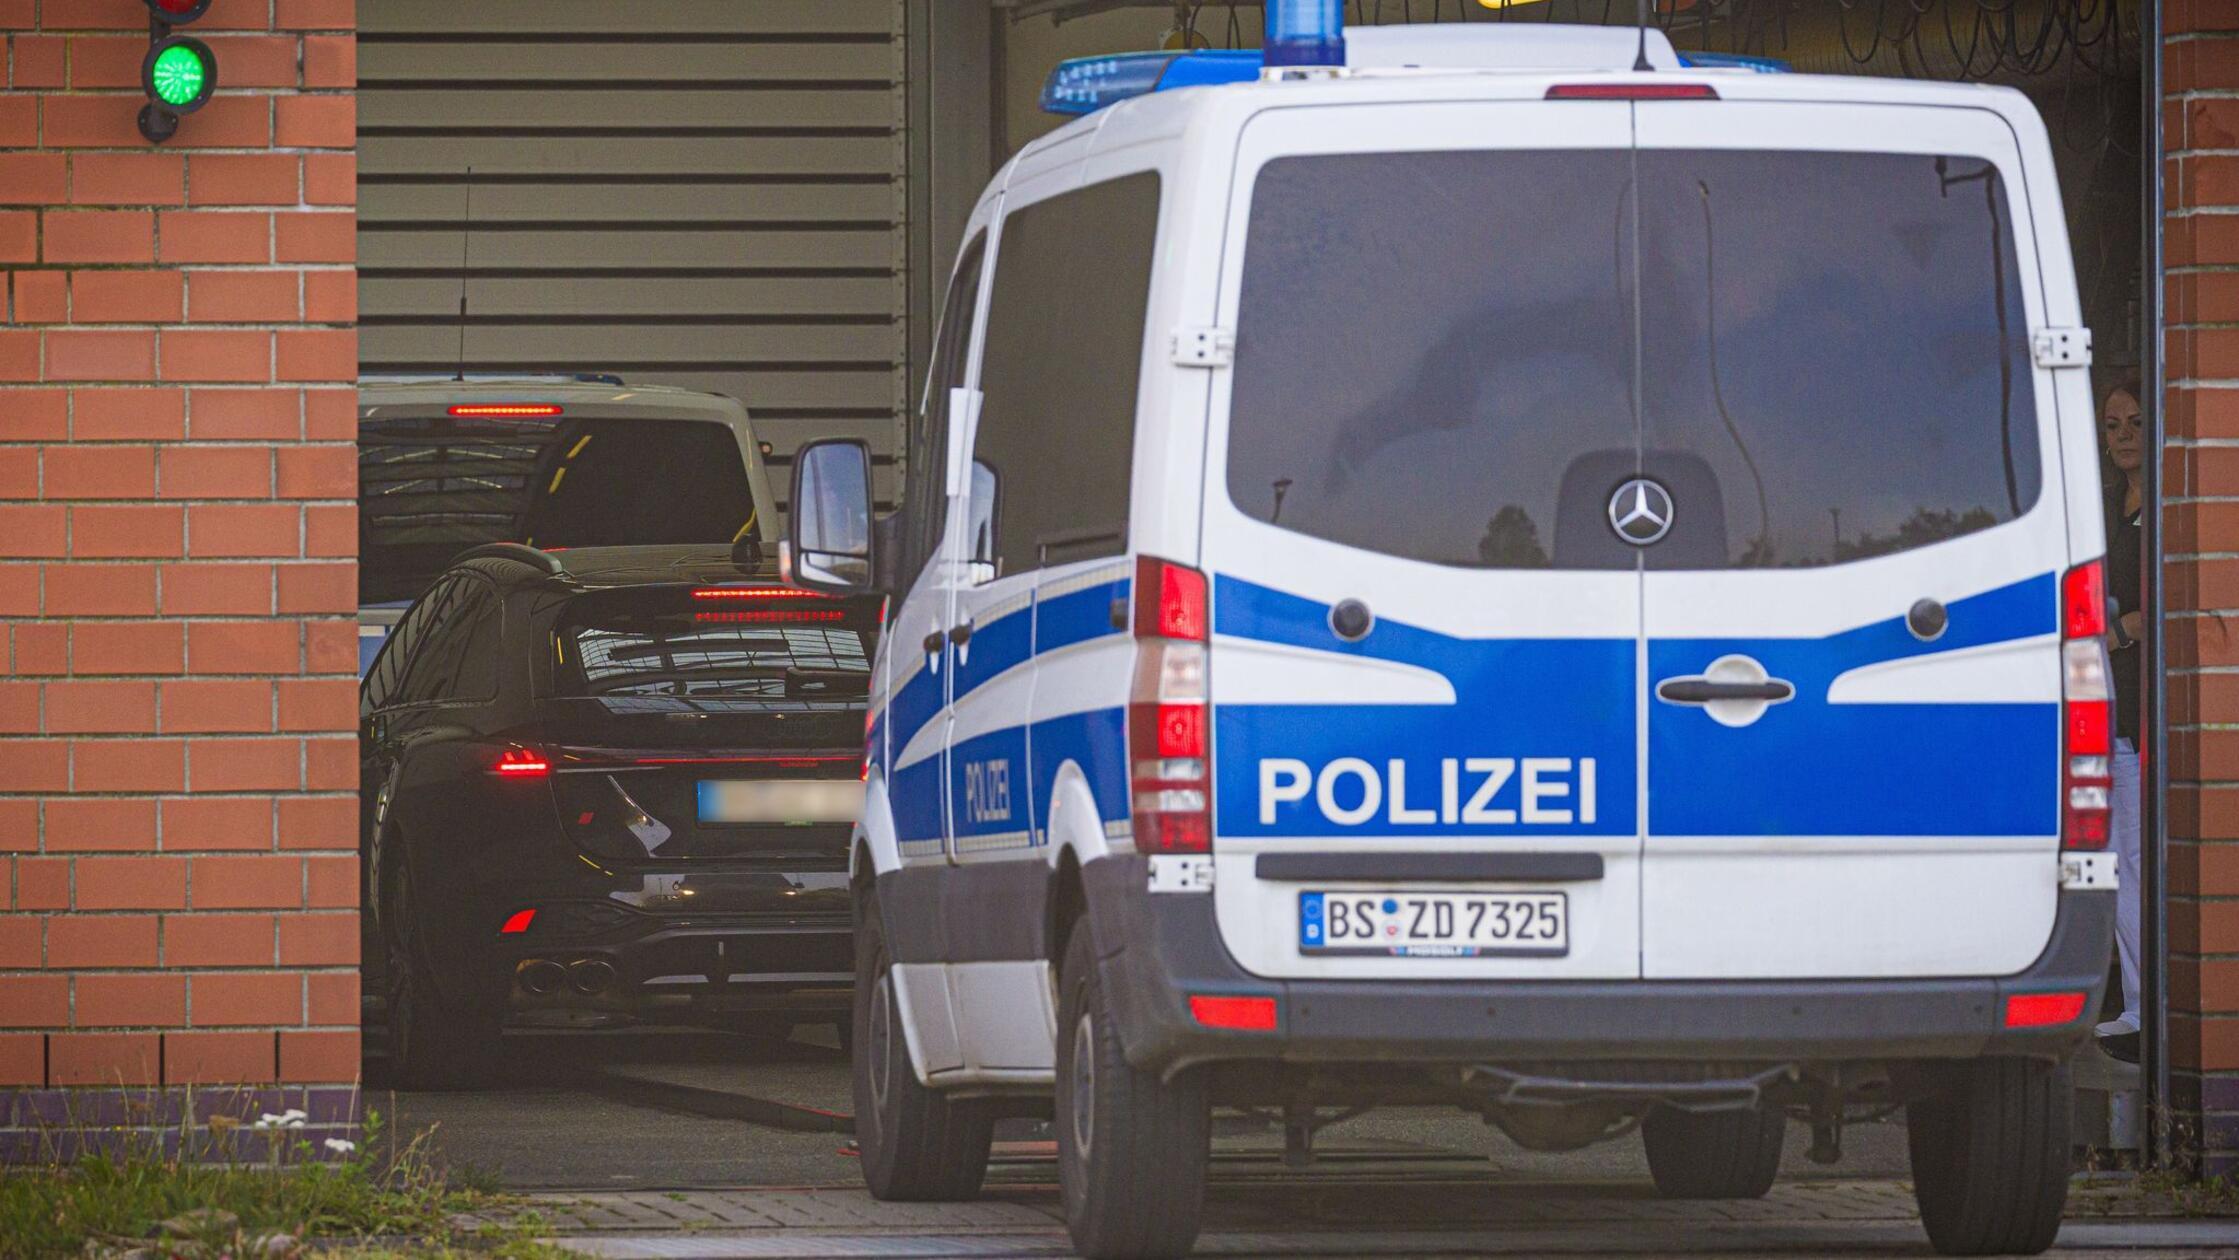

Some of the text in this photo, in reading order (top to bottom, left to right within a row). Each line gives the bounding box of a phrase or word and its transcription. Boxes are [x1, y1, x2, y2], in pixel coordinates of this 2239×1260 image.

[965, 758, 1011, 823] POLIZEI
[1259, 757, 1596, 826] POLIZEI
[1329, 900, 1559, 939] BS ZD 7325
